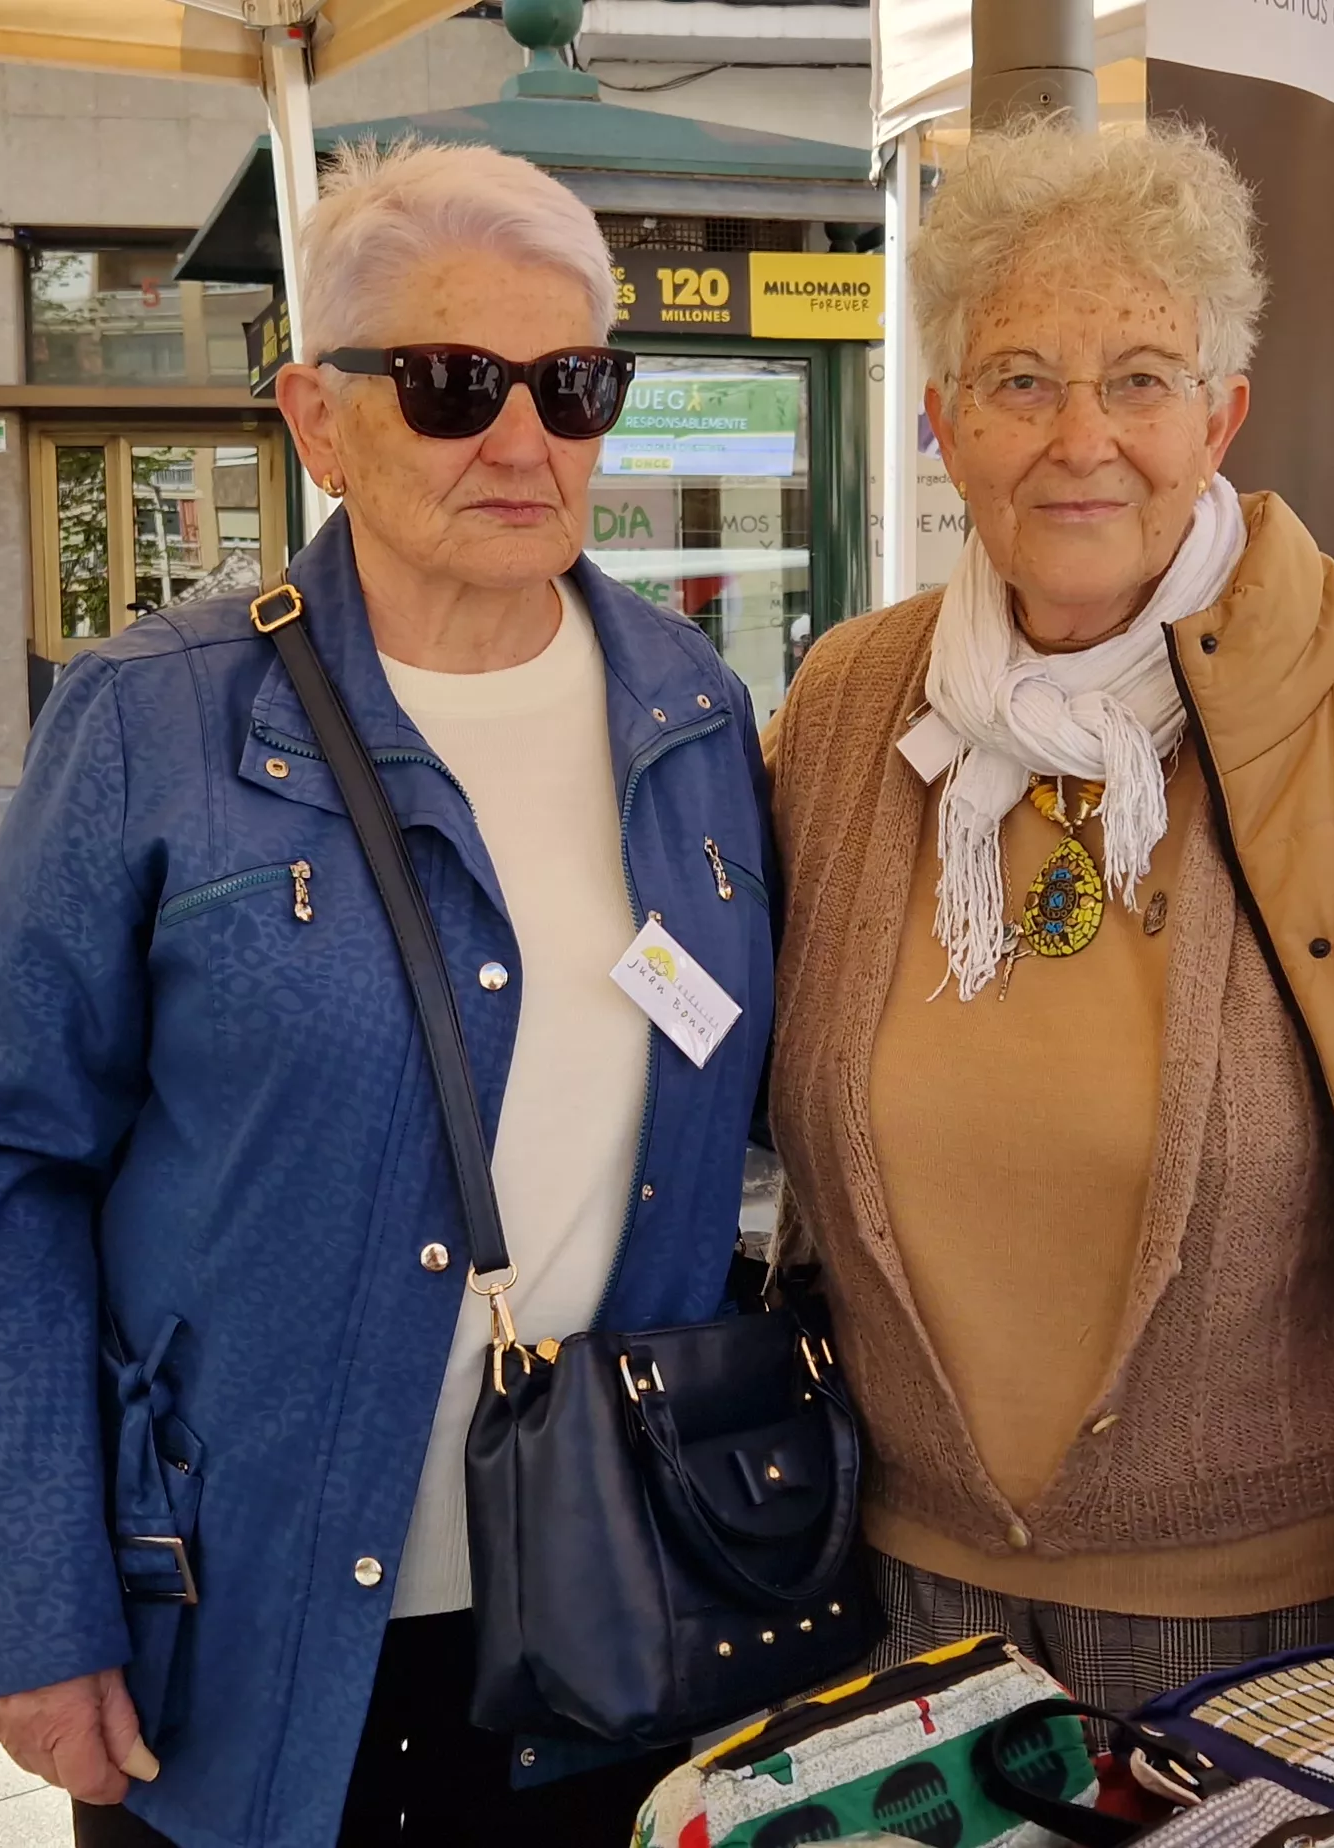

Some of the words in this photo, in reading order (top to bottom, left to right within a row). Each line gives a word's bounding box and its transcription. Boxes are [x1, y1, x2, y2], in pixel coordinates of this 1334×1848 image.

[141, 277, 161, 308] 5
[657, 267, 730, 306] 120
[763, 281, 871, 297] MILLONARIO
[661, 309, 731, 323] MILLONES
[624, 416, 748, 430] RESPONSABLEMENTE
